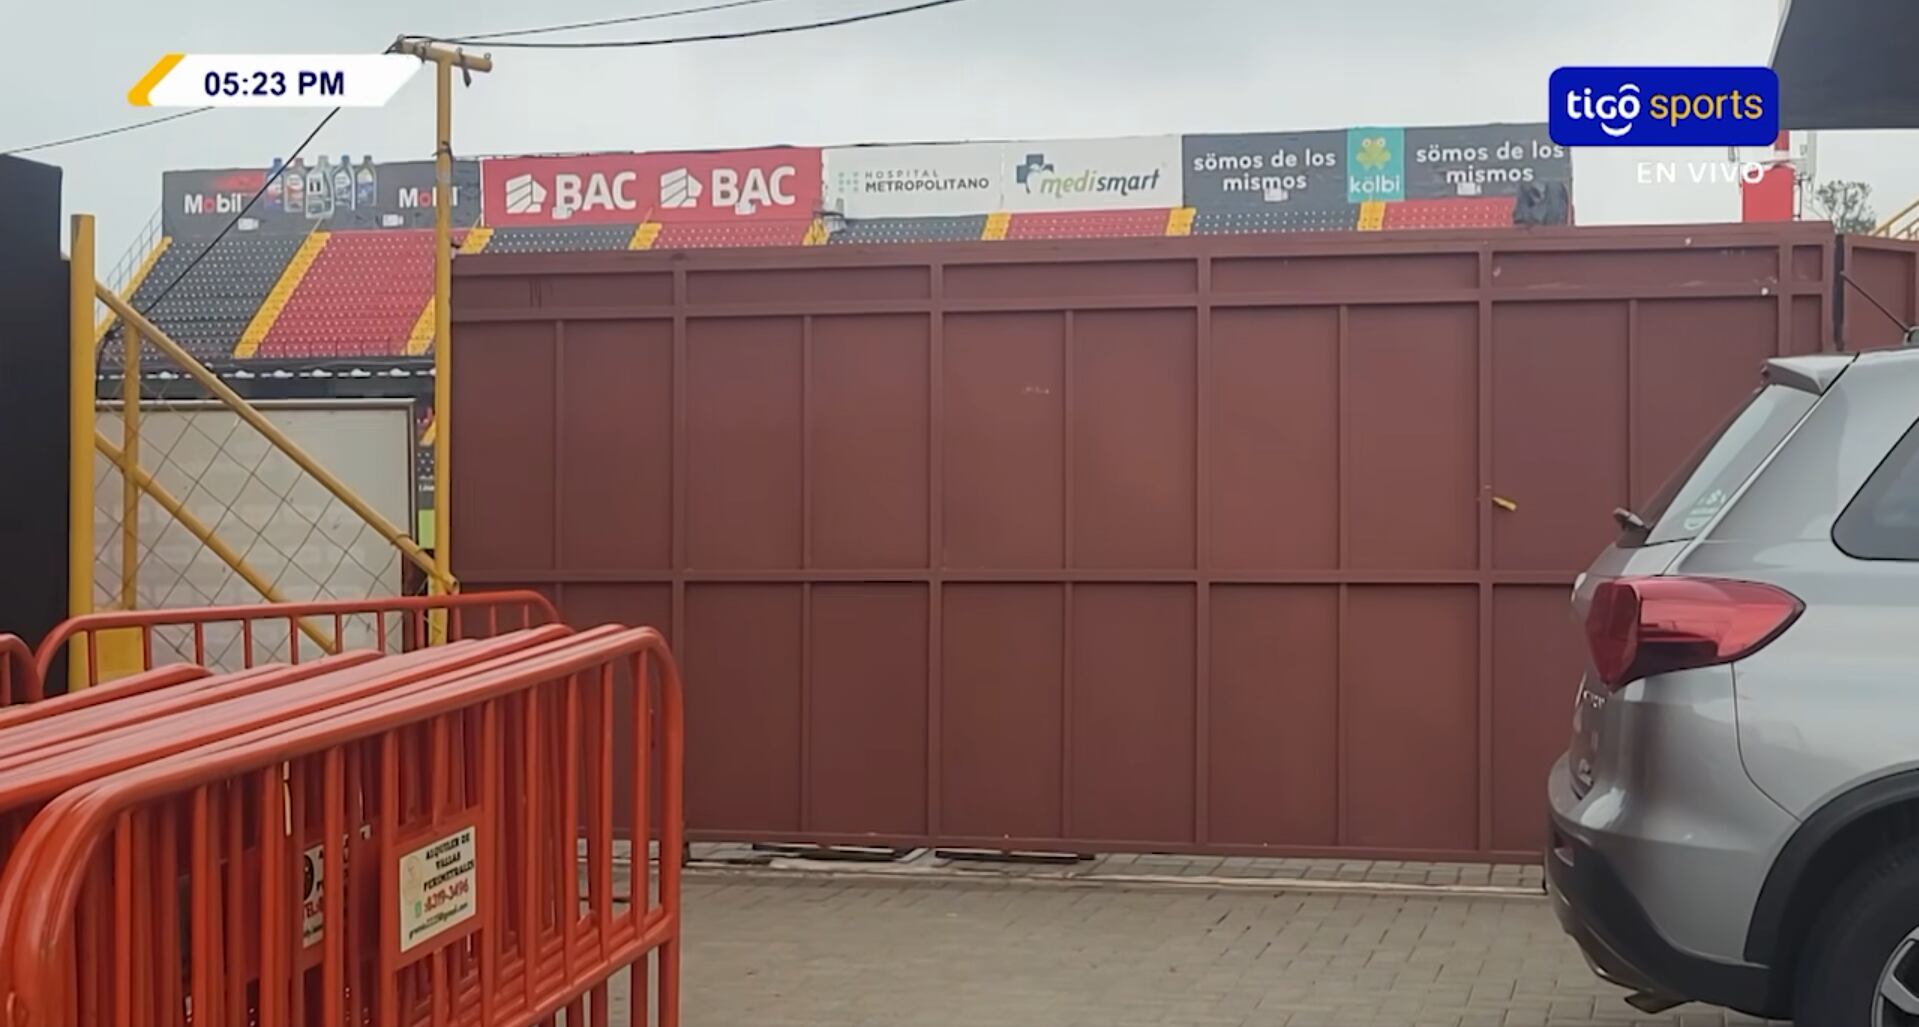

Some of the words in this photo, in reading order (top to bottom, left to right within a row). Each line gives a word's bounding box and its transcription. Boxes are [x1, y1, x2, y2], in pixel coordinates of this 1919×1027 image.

[1273, 149, 1298, 168] de
[1305, 148, 1337, 168] los
[1496, 141, 1519, 161] de
[1531, 140, 1564, 160] los
[865, 168, 939, 179] HOSPITAL
[1040, 168, 1161, 199] medismart
[1223, 172, 1308, 193] mismos
[1445, 165, 1535, 185] mismos
[555, 171, 638, 212] BAC
[711, 165, 797, 207] BAC
[865, 177, 990, 194] METROPOLITANO
[184, 192, 242, 214] Mobil
[399, 186, 458, 208] Mol
